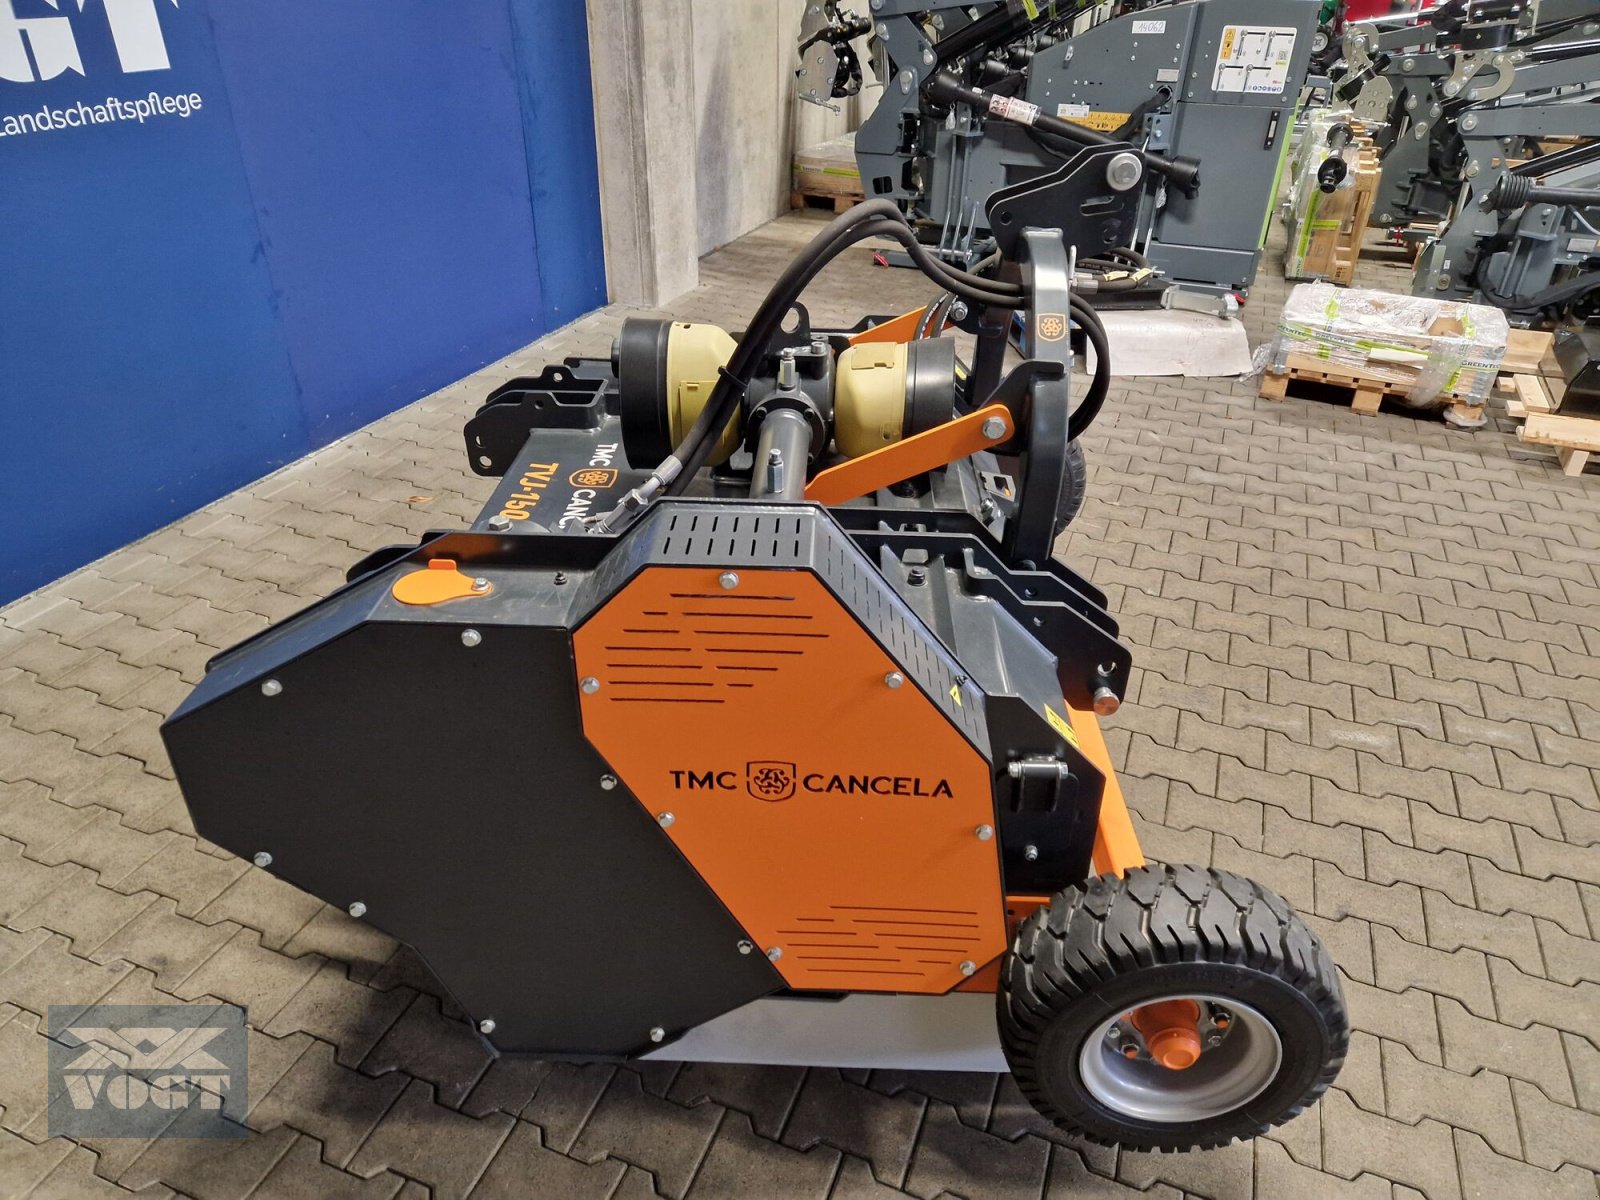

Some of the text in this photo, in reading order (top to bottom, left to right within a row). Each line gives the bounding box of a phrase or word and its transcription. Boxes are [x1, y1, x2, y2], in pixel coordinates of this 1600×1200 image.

[0, 92, 202, 137] andschaftspflege
[589, 443, 618, 467] TMC
[499, 462, 560, 520] TVJ-150
[669, 770, 954, 799] TMC CANCELA
